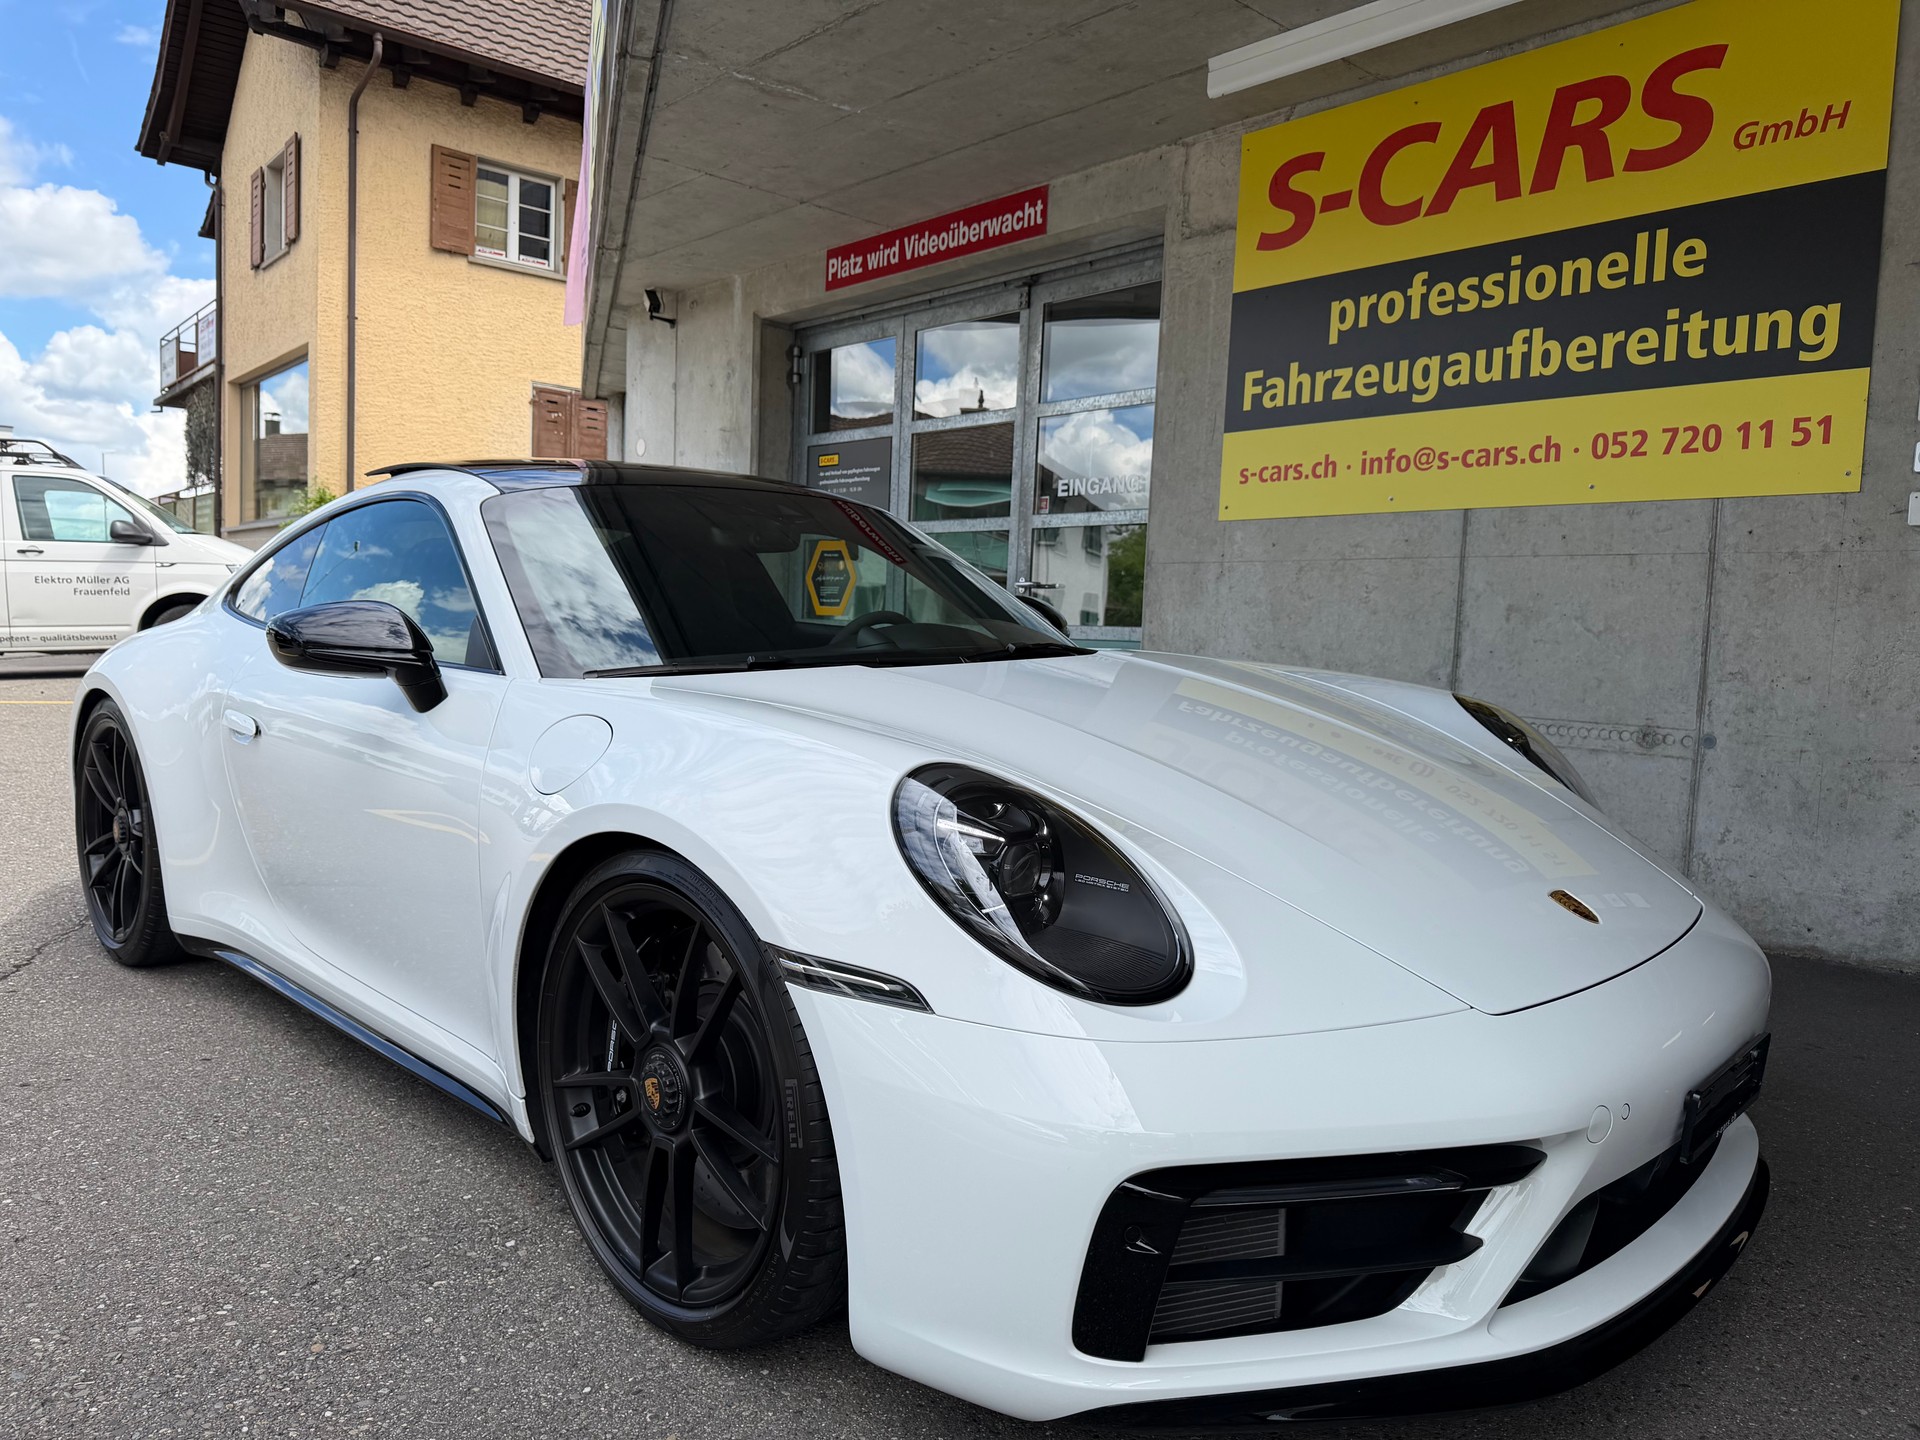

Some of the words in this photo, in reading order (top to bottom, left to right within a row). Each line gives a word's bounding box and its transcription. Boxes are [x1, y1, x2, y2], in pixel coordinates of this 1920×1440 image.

[1256, 43, 1729, 252] S-CARS
[1732, 100, 1851, 151] GmbH
[827, 257, 864, 282] Platz
[866, 240, 900, 270] wird
[903, 199, 1044, 260] Videoüberwacht
[1328, 227, 1708, 345] professionelle
[1242, 303, 1842, 412] Fahrzeugaufbereitung
[1239, 454, 1337, 485] s-cars.ch
[1360, 435, 1562, 476] info@s-cars.ch
[1591, 429, 1649, 460] 052
[1662, 423, 1723, 455] 720
[1736, 419, 1774, 449] 11
[1791, 415, 1833, 447] 51
[1057, 474, 1142, 497] EINGANG
[34, 575, 72, 584] Elektro
[76, 575, 111, 584] Müller
[113, 575, 130, 584] AG
[73, 587, 131, 596] Frauenfeld
[0, 633, 31, 643] petent
[40, 633, 117, 644] qualitätsbewusst
[1075, 873, 1130, 889] PORSCHE
[606, 1019, 618, 1072] PORSC
[784, 1078, 803, 1149] PIRELLI
